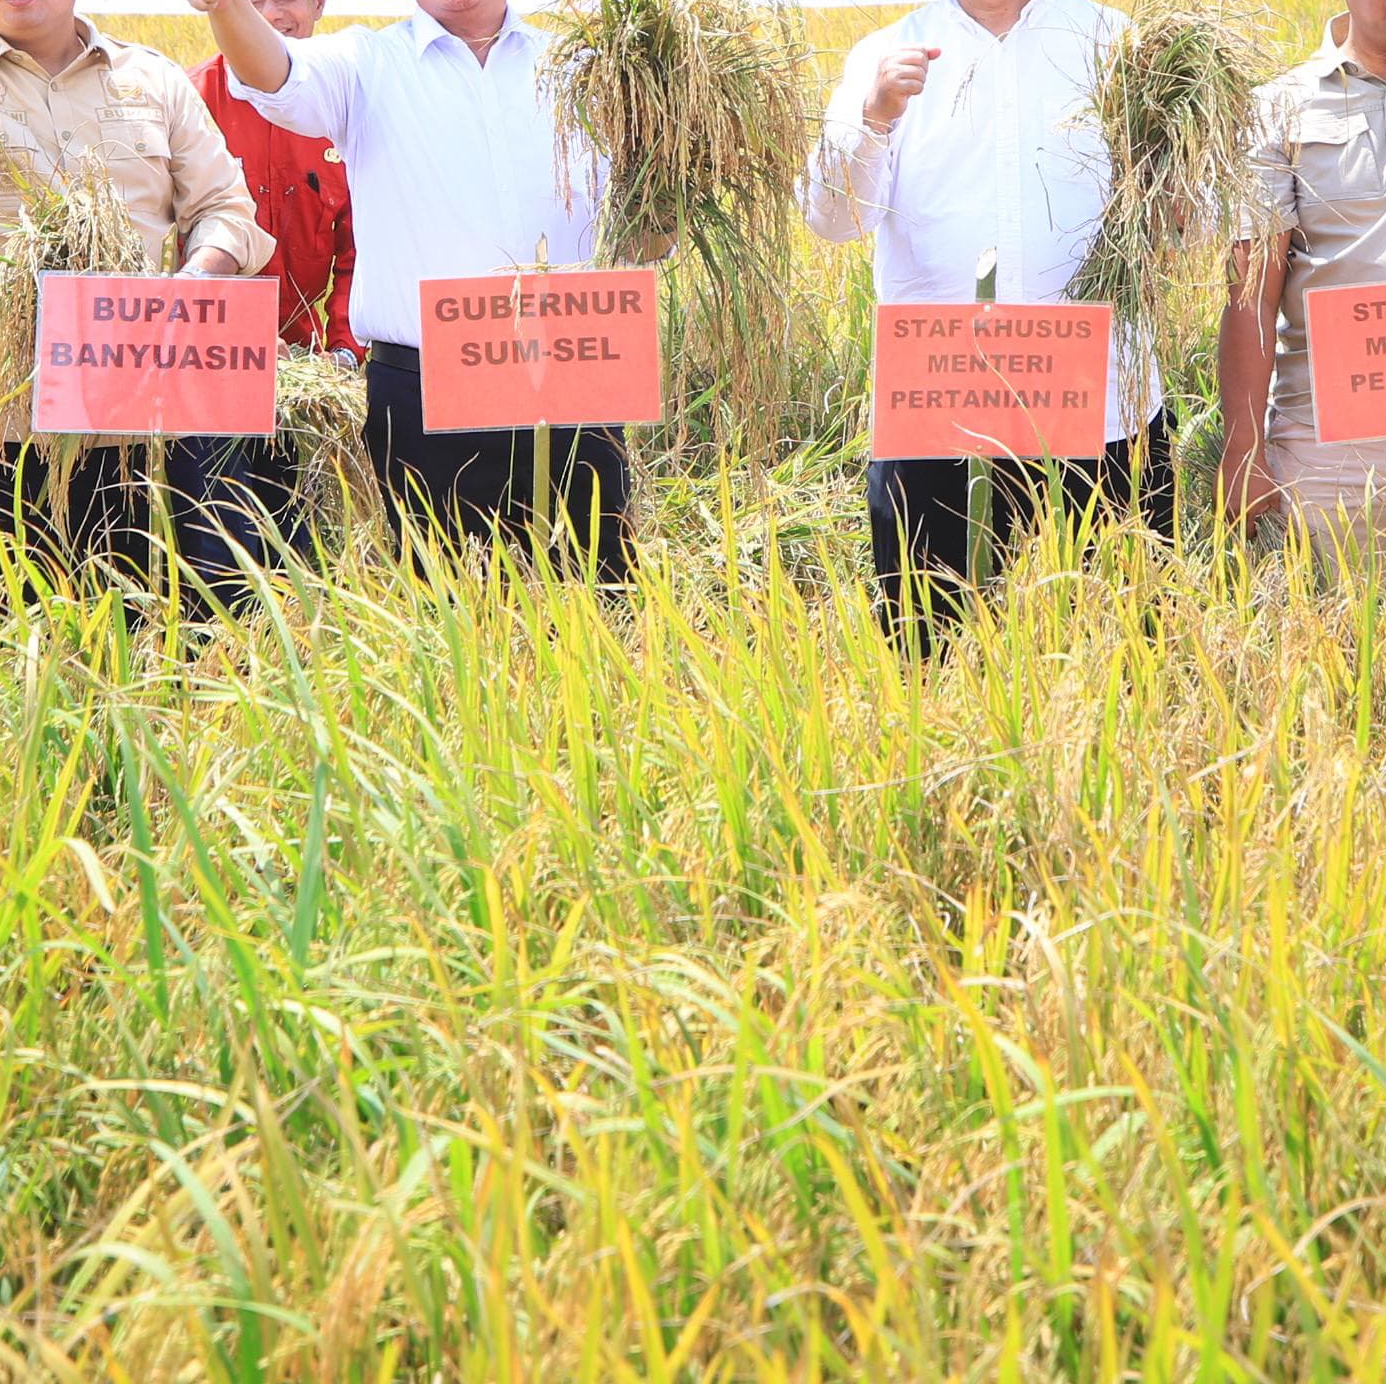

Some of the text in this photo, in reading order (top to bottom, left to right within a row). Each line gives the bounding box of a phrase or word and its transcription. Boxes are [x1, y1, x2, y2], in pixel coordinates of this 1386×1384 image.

[93, 296, 226, 324] BUPATI
[435, 289, 643, 322] GUBERNUR
[893, 318, 1092, 339] STAF KHUSUS
[51, 342, 267, 371] BANYUASIN
[460, 336, 621, 366] SUM-SEL
[927, 354, 1053, 373] MENTERI
[890, 389, 1088, 409] PERTANIAN RI
